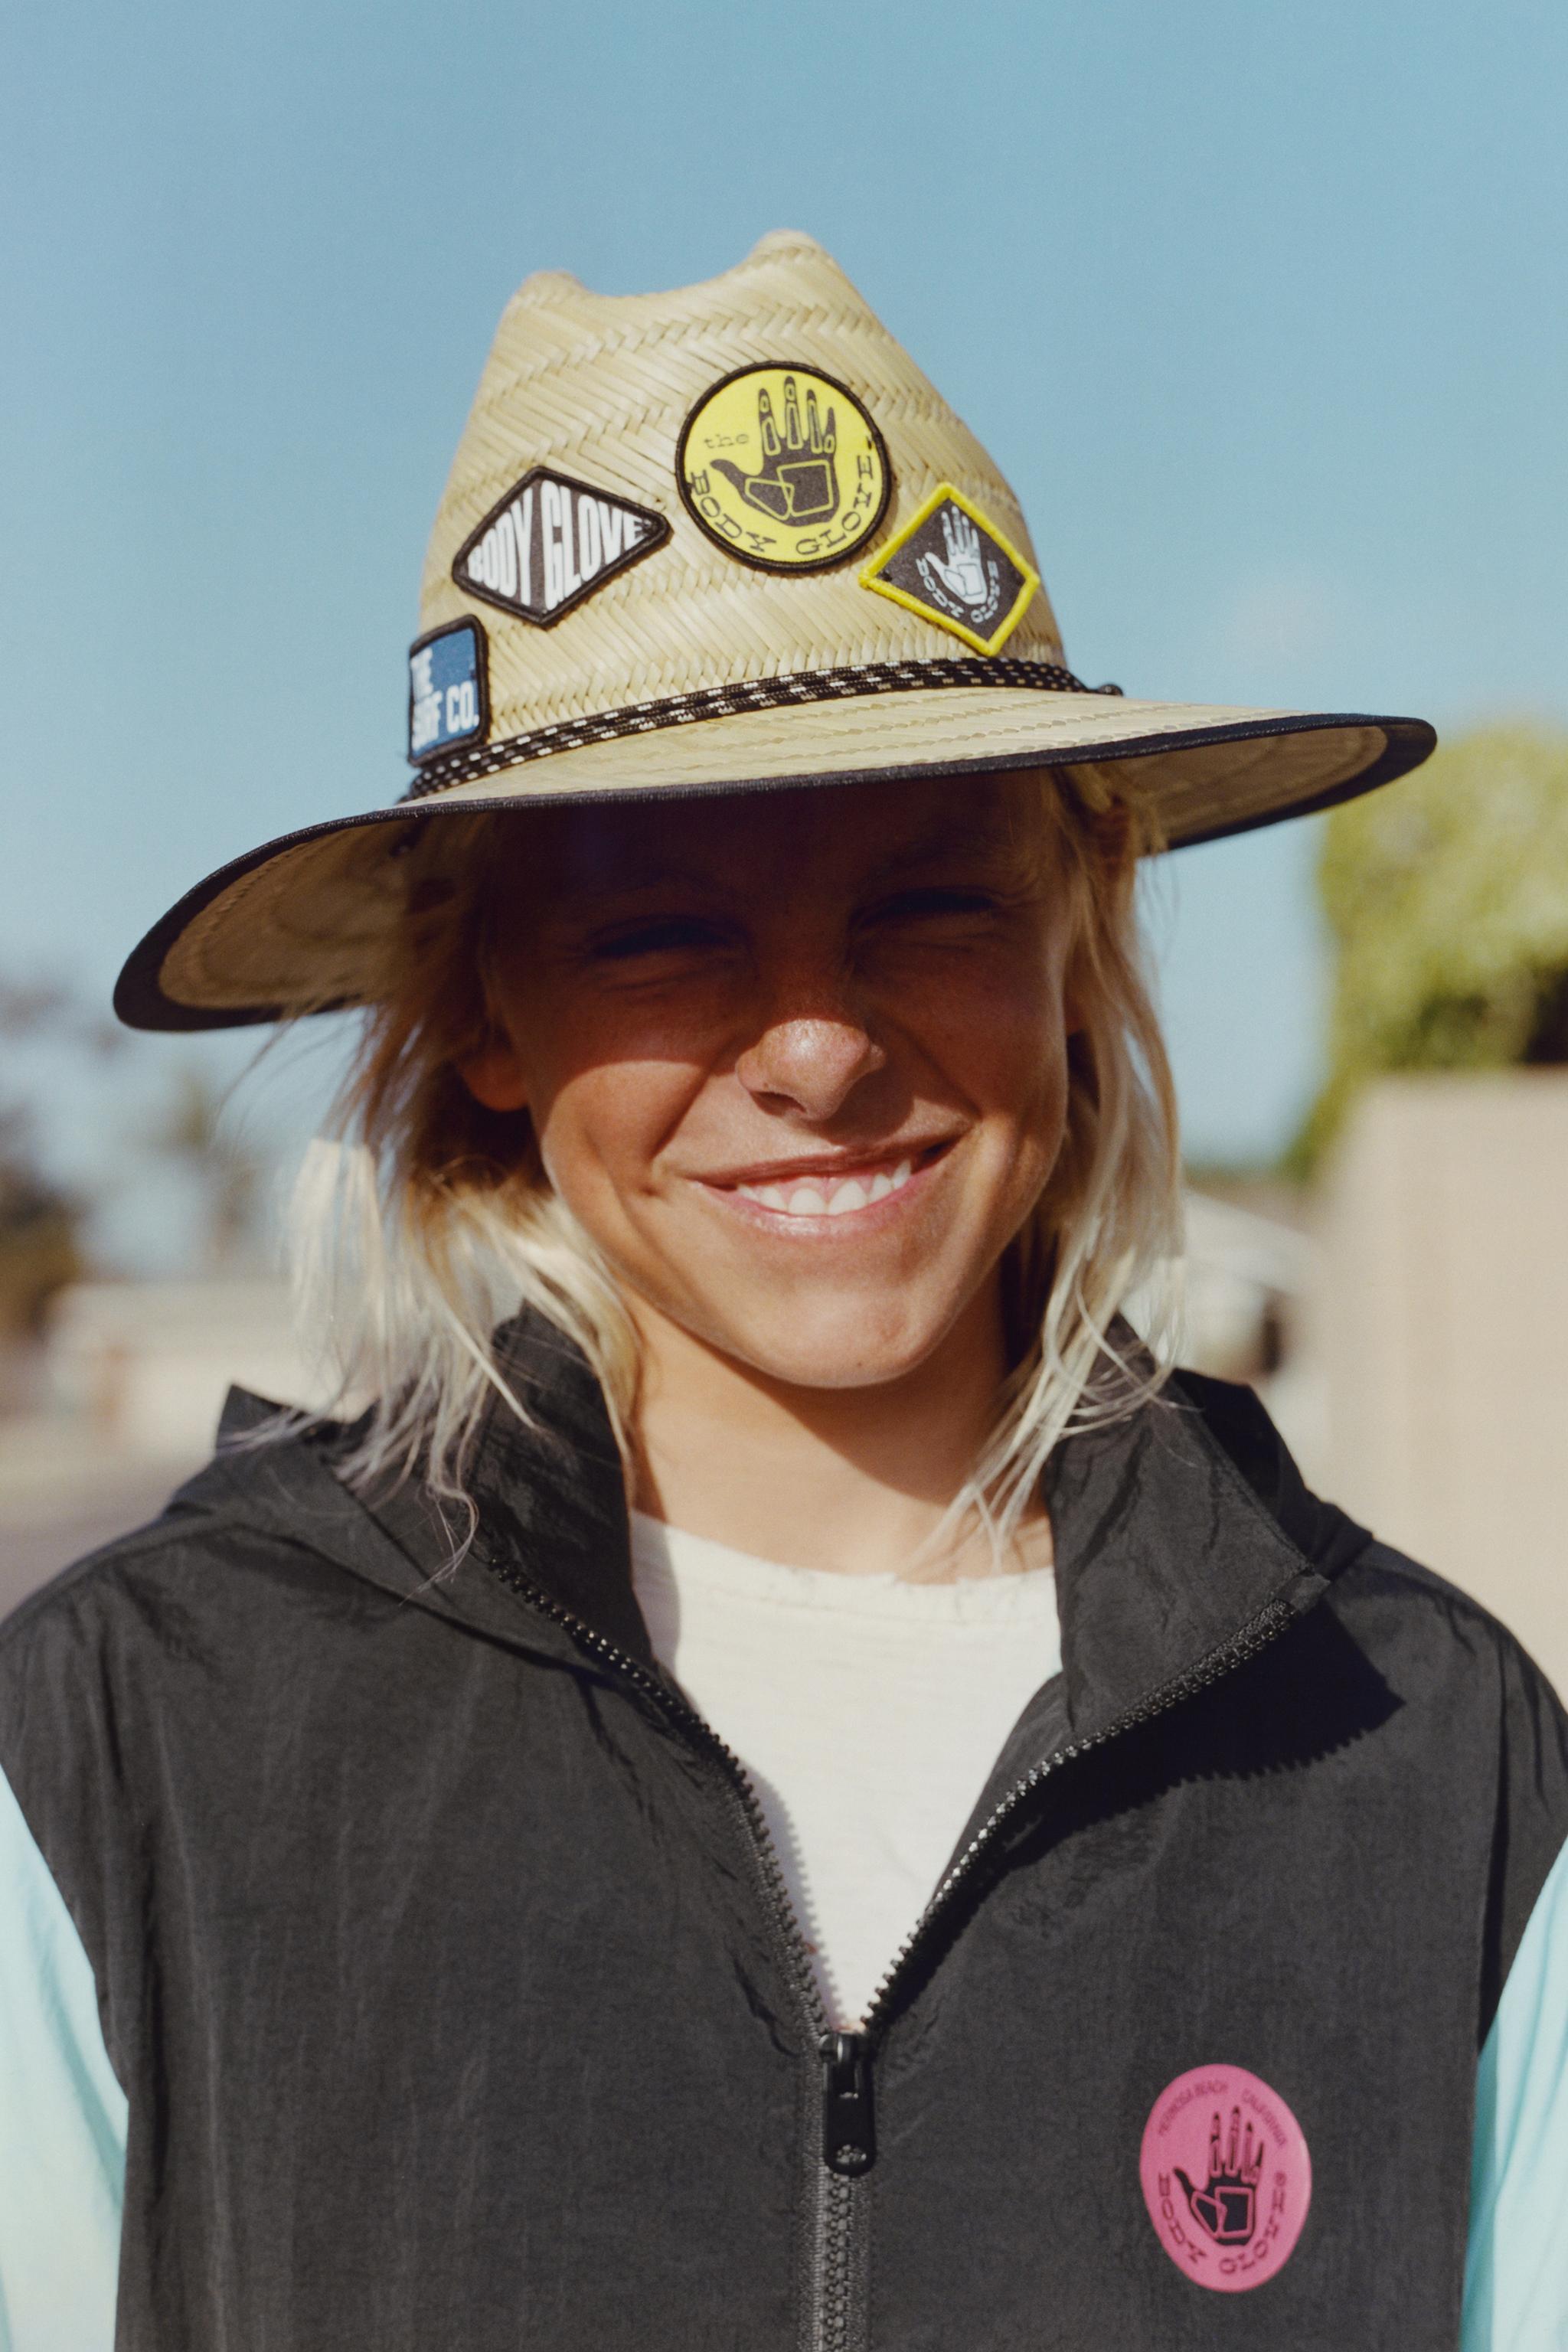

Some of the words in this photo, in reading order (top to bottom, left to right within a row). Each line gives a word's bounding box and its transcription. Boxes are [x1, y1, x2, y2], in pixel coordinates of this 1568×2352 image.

[704, 433, 750, 449] the
[691, 469, 777, 553] BODY
[795, 455, 873, 556] GLOVE
[467, 486, 533, 606] BODY
[541, 479, 652, 611] GLOVE
[916, 557, 964, 618] BODY
[446, 680, 480, 734] CO.
[1158, 2171, 1207, 2264] BODY
